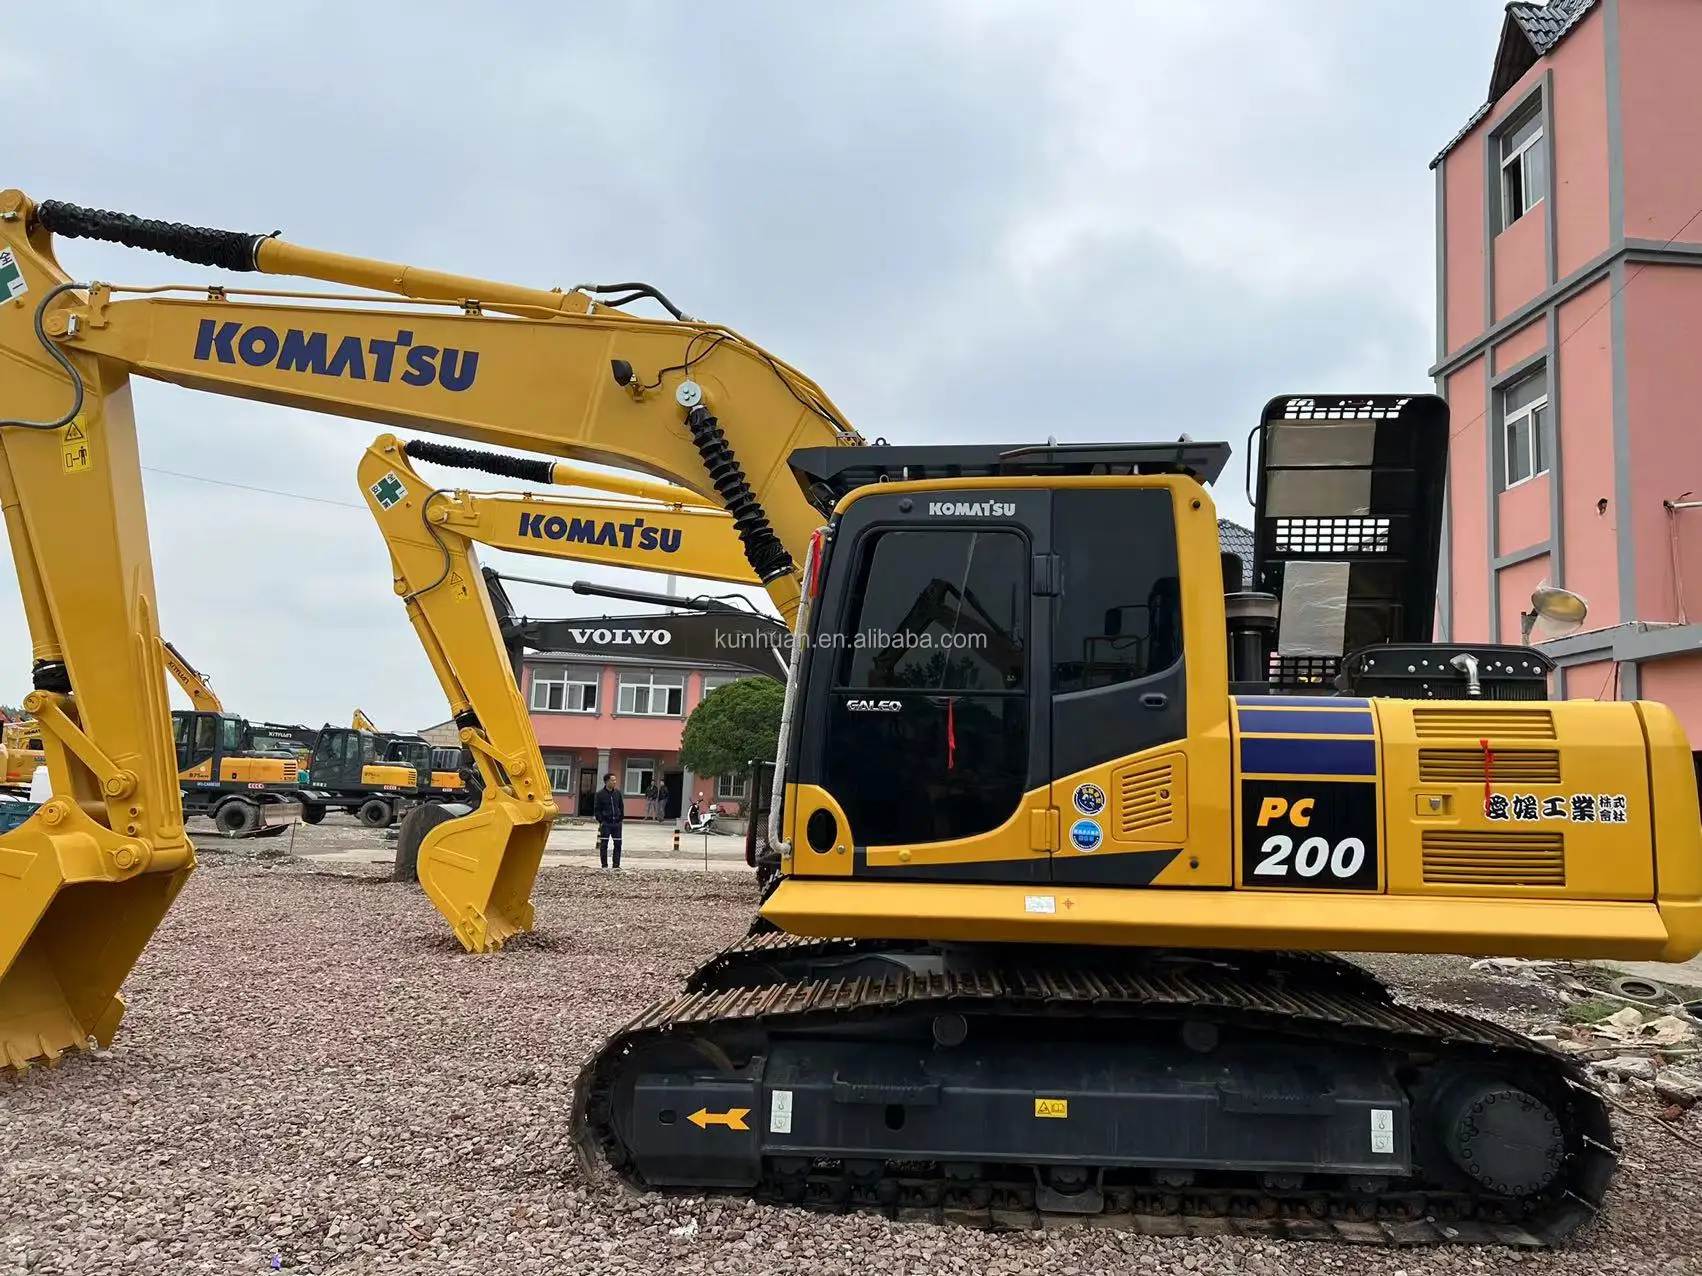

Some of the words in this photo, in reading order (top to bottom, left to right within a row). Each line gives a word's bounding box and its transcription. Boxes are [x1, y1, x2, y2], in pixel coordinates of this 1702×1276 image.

[194, 319, 479, 391] KOMATSU
[929, 500, 1015, 517] KOMATSU
[518, 512, 682, 553] KOMATSU
[568, 628, 672, 646] VOLVO
[846, 700, 902, 712] GALEO
[1257, 797, 1315, 828] PC
[1253, 834, 1365, 878] 200
